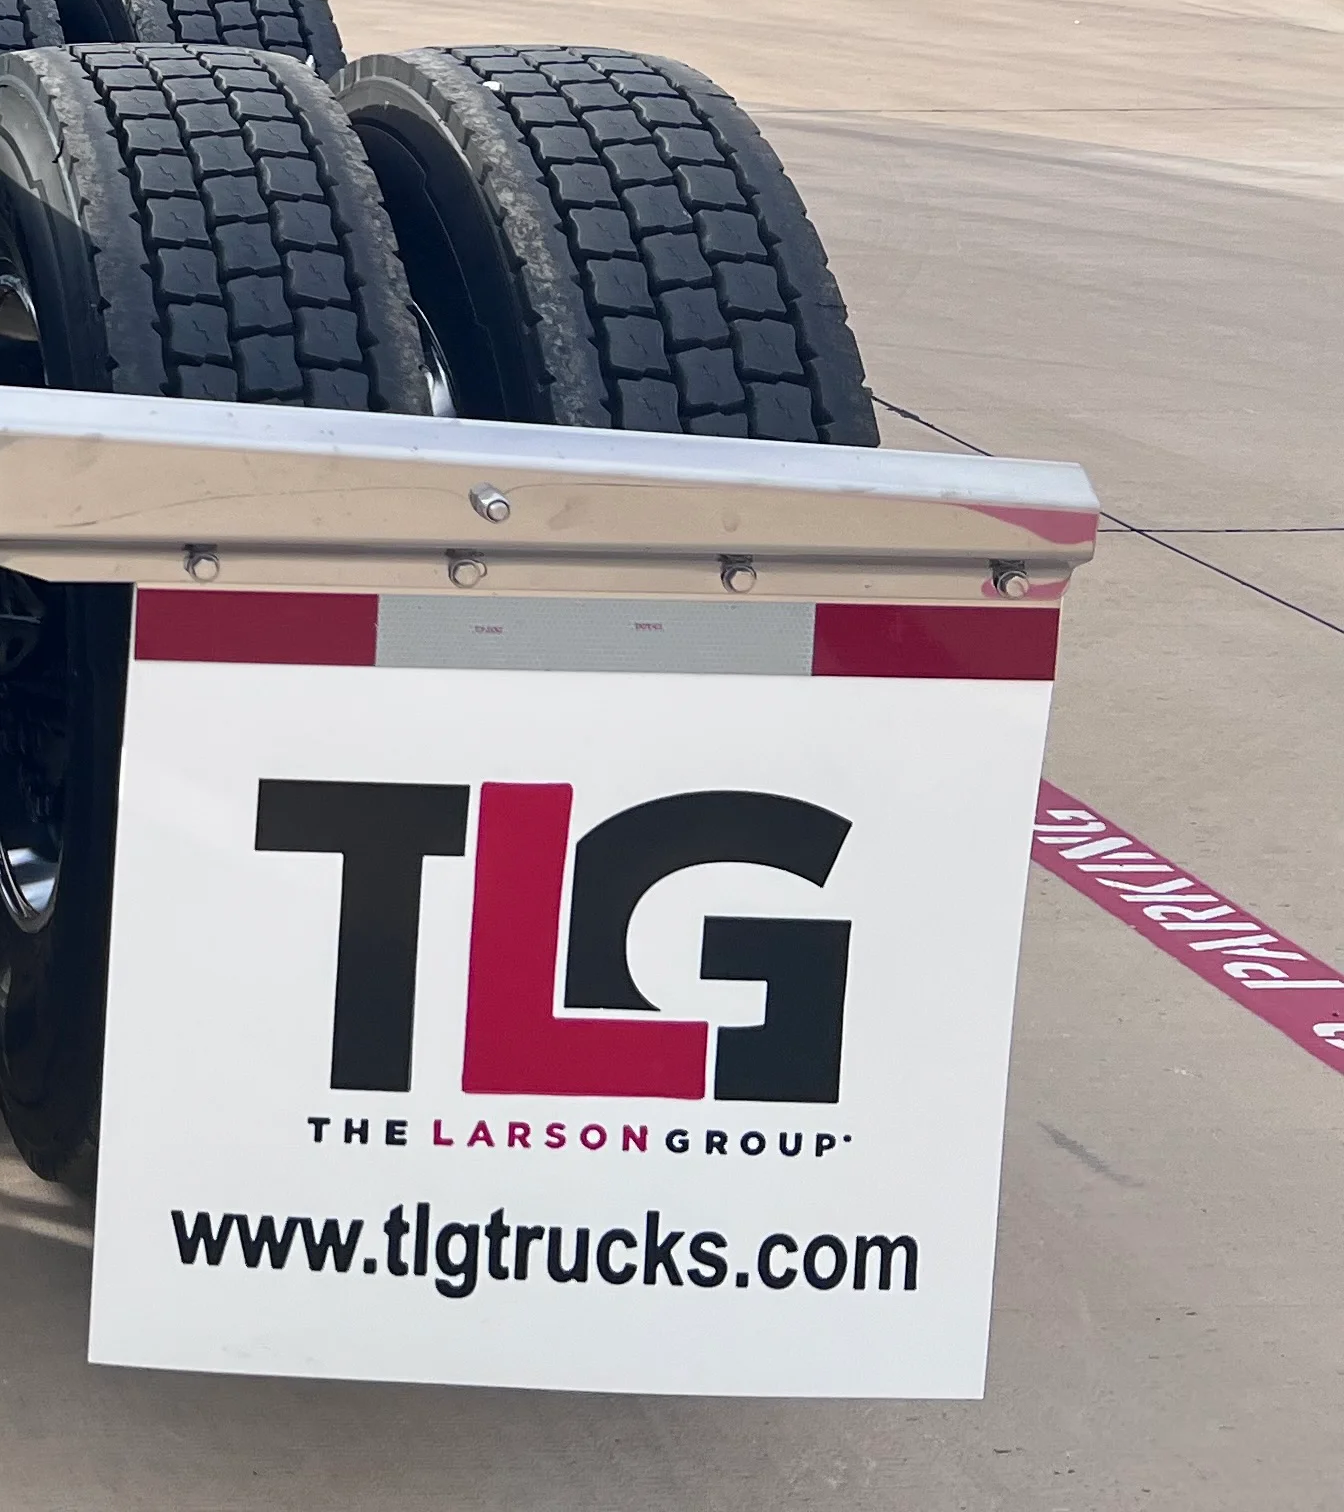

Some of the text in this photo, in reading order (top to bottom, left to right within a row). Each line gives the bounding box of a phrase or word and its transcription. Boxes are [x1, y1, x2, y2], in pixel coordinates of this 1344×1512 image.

[255, 777, 853, 1103] TLG
[1033, 808, 1344, 990] PARKING
[307, 1116, 409, 1147] THE
[433, 1118, 649, 1152] LARSON
[170, 1202, 918, 1299] www.tlgtrucks.com
